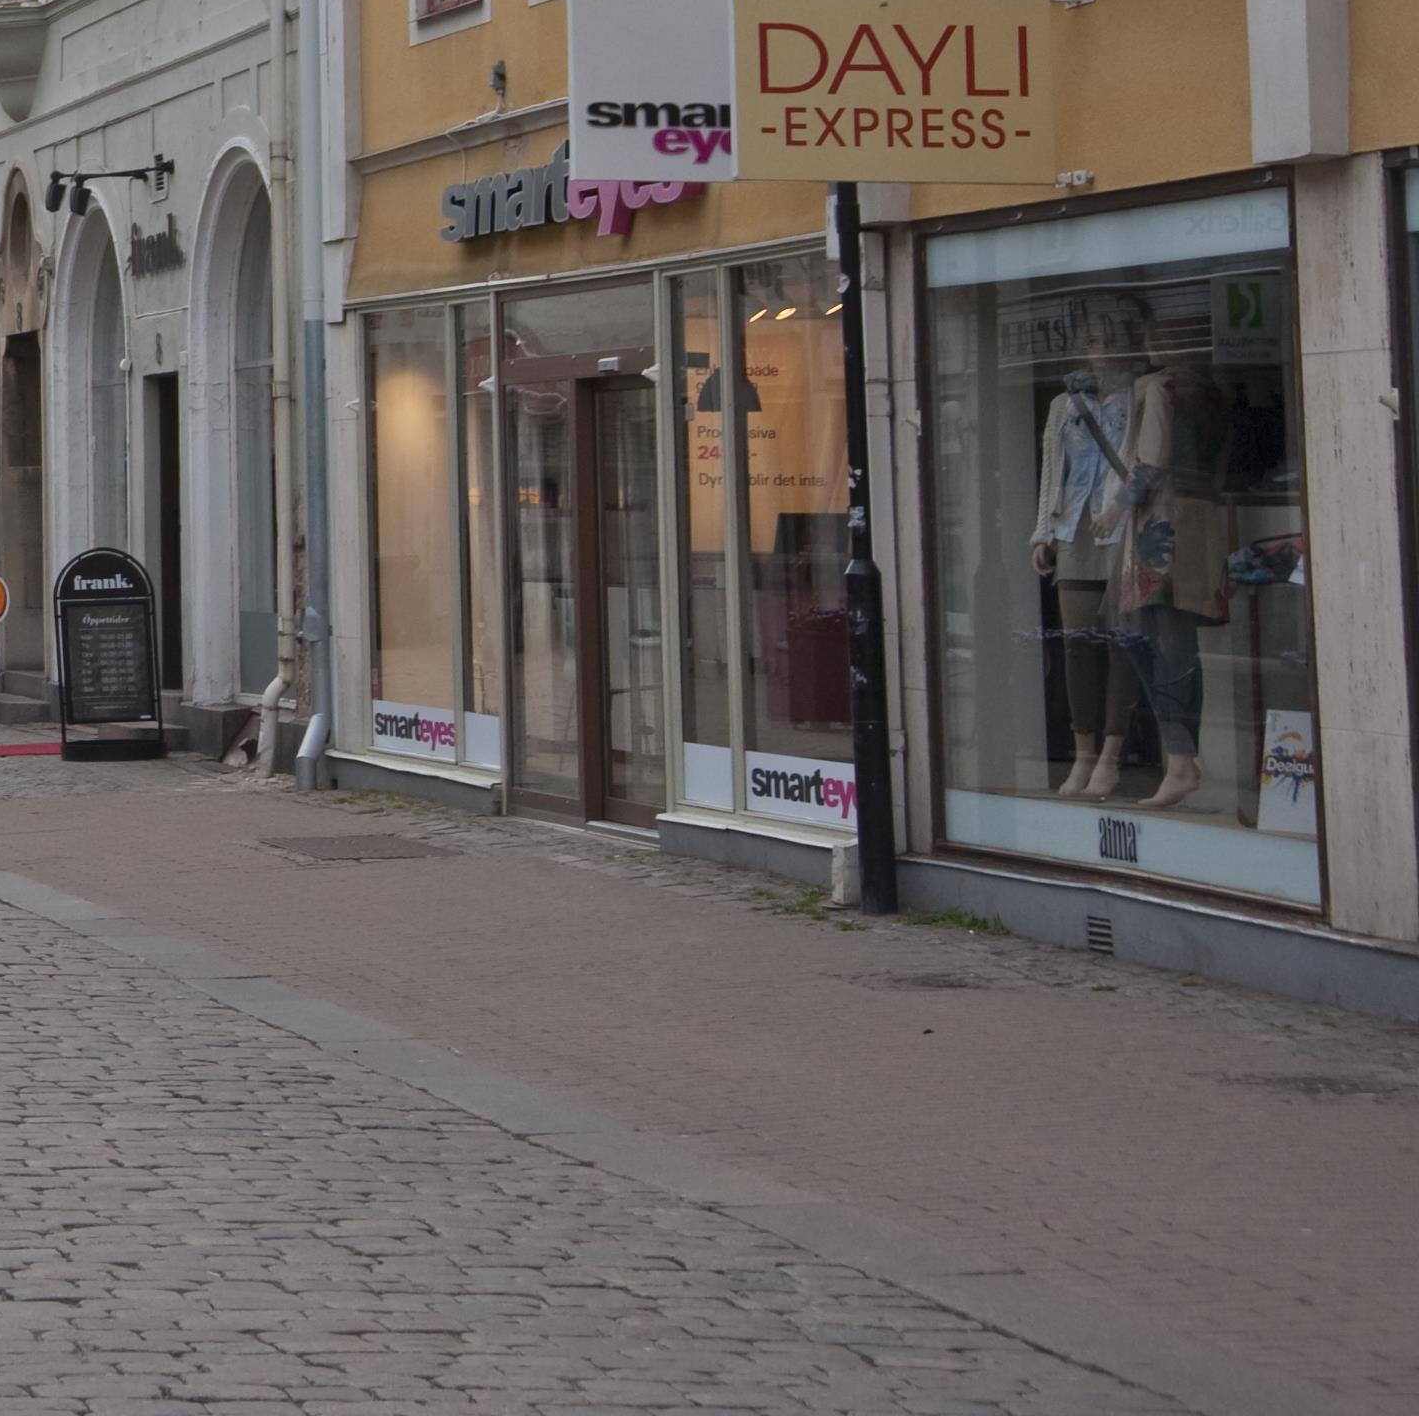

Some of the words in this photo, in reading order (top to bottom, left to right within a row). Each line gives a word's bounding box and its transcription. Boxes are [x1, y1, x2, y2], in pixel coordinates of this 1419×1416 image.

[758, 22, 1029, 97] DAYLI
[587, 101, 731, 128] smar
[773, 473, 795, 486] det
[73, 573, 134, 591] frank.
[374, 711, 455, 752] smarteyes
[1266, 759, 1314, 775] Desigu
[751, 767, 858, 820] smartey
